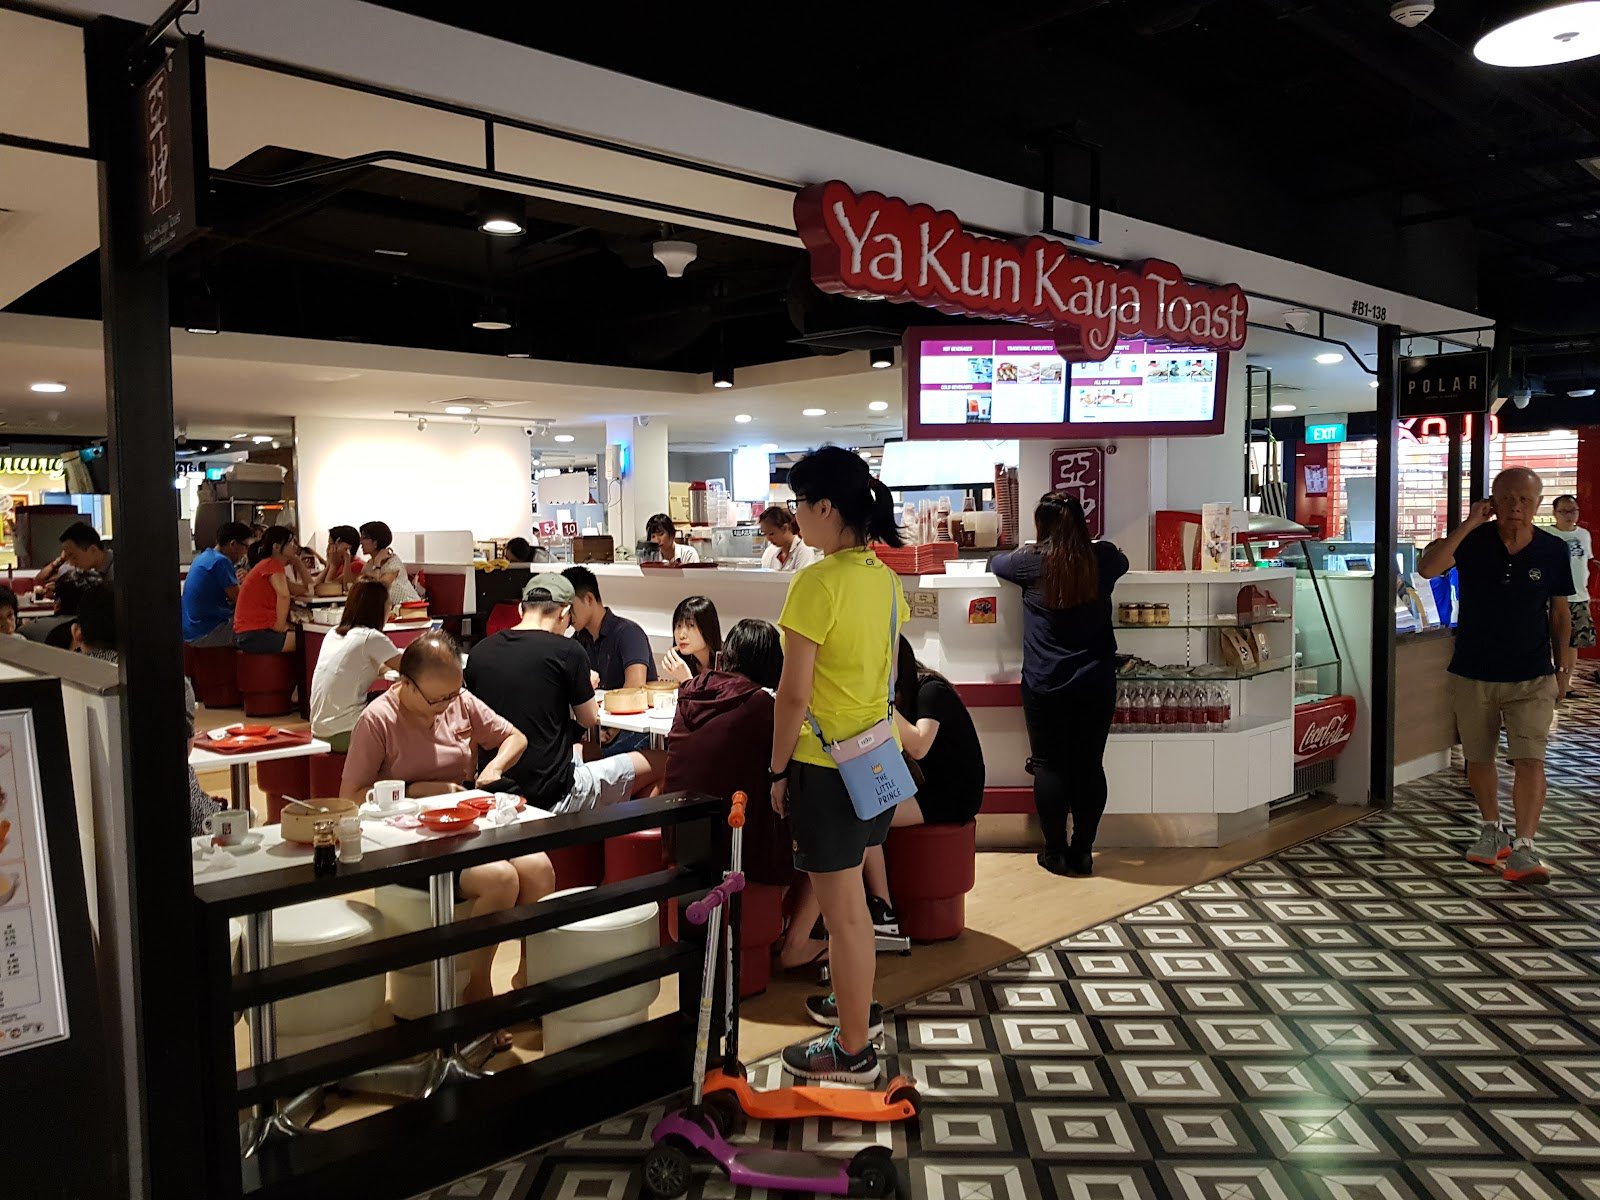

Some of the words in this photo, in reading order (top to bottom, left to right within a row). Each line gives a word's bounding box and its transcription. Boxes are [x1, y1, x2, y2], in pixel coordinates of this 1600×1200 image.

[833, 201, 904, 281] Ya
[918, 221, 1021, 302] Kun
[1034, 247, 1141, 351] Kaya
[1146, 272, 1245, 343] Toast
[1351, 300, 1387, 321] #B1-138
[1408, 375, 1478, 396] POLAR
[1313, 427, 1337, 441] EXIT
[874, 779, 897, 796] LITTLE
[875, 773, 889, 784] THE
[877, 787, 902, 806] PRINCE
